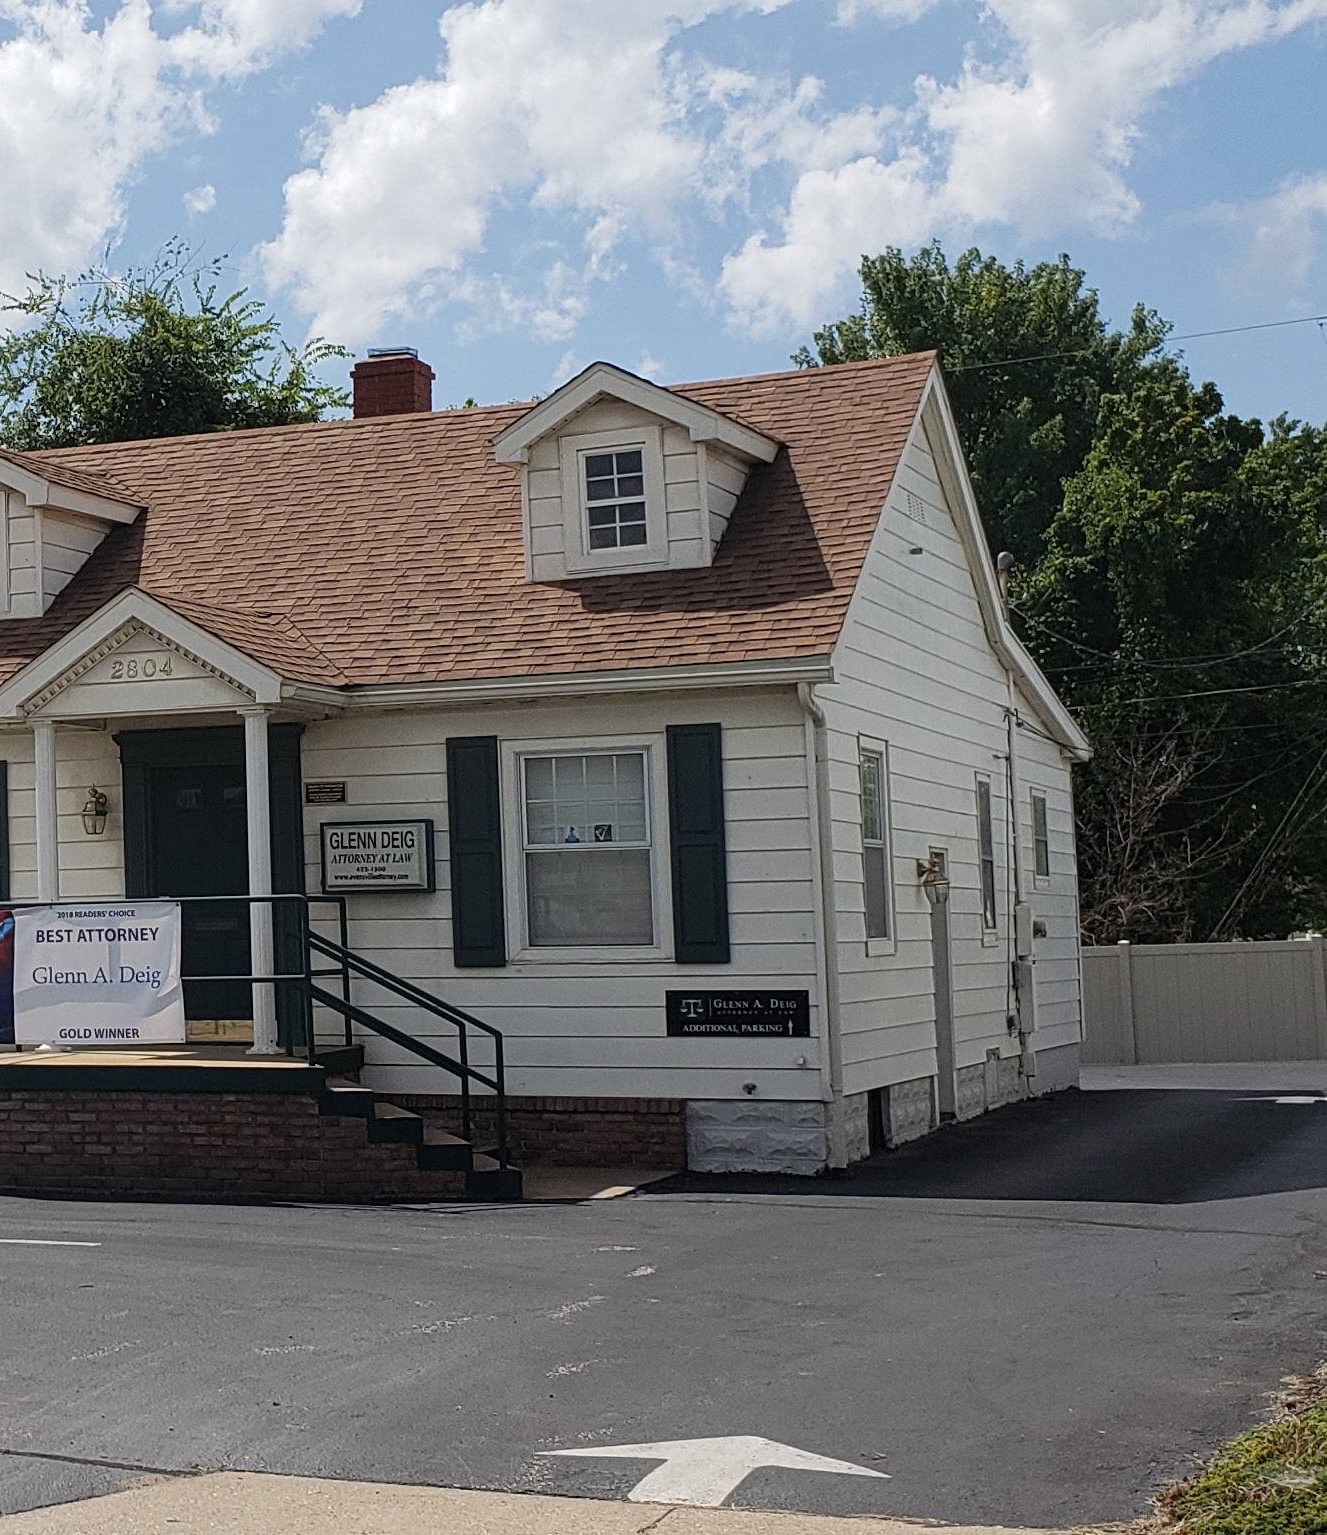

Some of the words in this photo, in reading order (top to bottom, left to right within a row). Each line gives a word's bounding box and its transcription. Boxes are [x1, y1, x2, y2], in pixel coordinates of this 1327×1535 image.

[111, 657, 172, 679] 2804
[329, 831, 377, 849] GLENN
[381, 830, 415, 848] DEIG
[331, 853, 378, 864] ATTORNEY
[379, 853, 391, 863] AT
[392, 852, 413, 863] LAW
[36, 929, 73, 943] BEST
[77, 927, 159, 942] ATTORNEY
[32, 966, 88, 984] Glenn
[92, 966, 113, 984] A.
[119, 965, 161, 989] Deig
[713, 998, 749, 1009] GLENN
[770, 998, 796, 1008] DEIG
[59, 1028, 92, 1039] GOLD
[94, 1028, 140, 1039] WINNER
[682, 1024, 738, 1033] ADDITIONAL
[741, 1024, 783, 1032] PARKING
